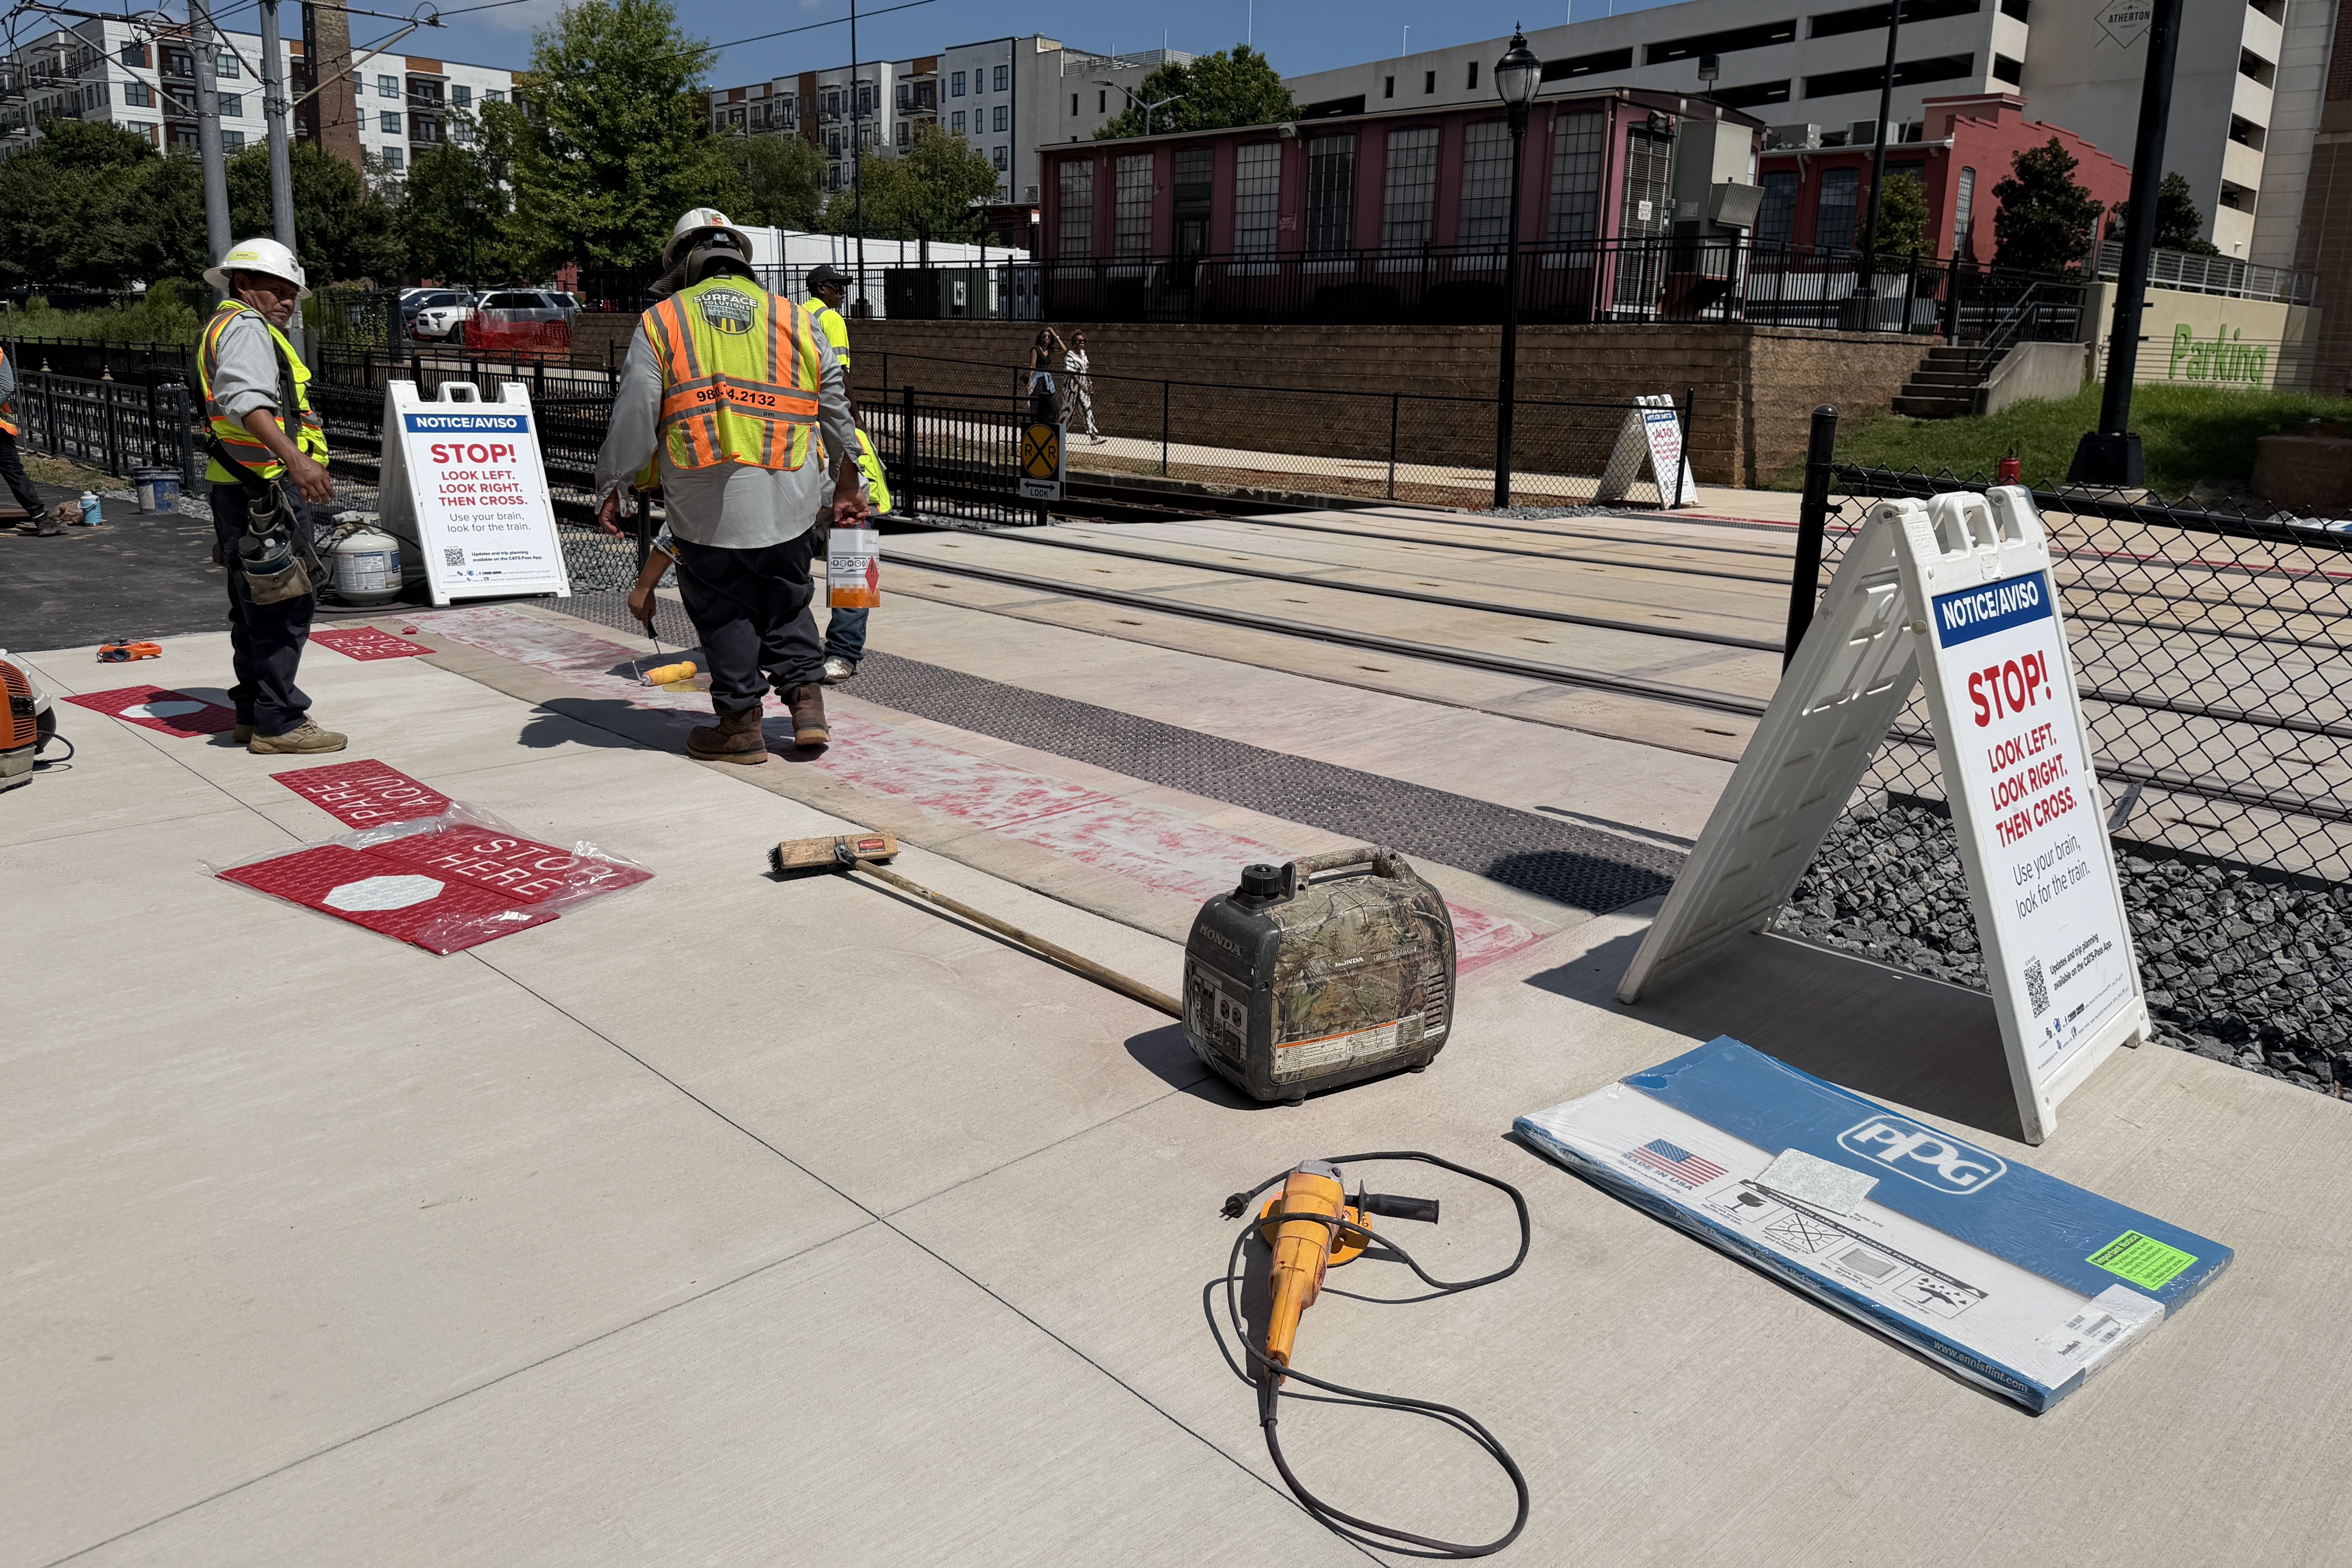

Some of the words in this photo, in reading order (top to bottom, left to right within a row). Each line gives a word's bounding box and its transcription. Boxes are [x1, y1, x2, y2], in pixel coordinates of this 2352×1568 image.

[2108, 11, 2150, 23] ATHERTON
[693, 294, 758, 308] SURFACE
[703, 301, 750, 310] SOLUTIONS
[2168, 323, 2268, 385] Parking
[416, 417, 517, 428] NOTICE/AVISO
[431, 443, 517, 464] STOP!
[1025, 443, 1032, 457] R
[1048, 446, 1056, 459] R
[439, 484, 477, 493] LOOK
[480, 483, 523, 493] RIGHT.
[441, 471, 479, 480] LOOK
[482, 471, 515, 480] LEFT.
[438, 497, 476, 506] THEN
[479, 496, 527, 506] CROSS.
[1031, 489, 1048, 497] LOOK
[448, 524, 469, 532] look
[472, 523, 485, 532] for
[450, 513, 469, 521] Use
[472, 514, 494, 523] your
[497, 512, 525, 520] brain,
[1942, 581, 2039, 630] NOTICE/AVISO
[358, 635, 418, 651] STOP
[1968, 650, 2051, 728] STOP!
[1988, 735, 2025, 774] LOOK
[2024, 722, 2057, 756] LEFT.
[1991, 772, 2029, 812] LOOK
[2028, 753, 2068, 793] RIGHT.
[307, 781, 396, 819] PARE
[1996, 808, 2033, 848] THEN
[2034, 786, 2077, 827] CROSS.
[426, 853, 565, 895] HERE
[474, 839, 613, 876] STOP
[2013, 863, 2033, 886] Use
[2033, 849, 2055, 880] your
[2054, 833, 2081, 861] brain,
[2016, 890, 2038, 919] look
[2038, 884, 2051, 905] for
[2052, 874, 2068, 896] the
[2067, 859, 2090, 885] train.
[1199, 923, 1242, 957] HONDA
[1335, 957, 1364, 967] HONDA
[1374, 946, 1416, 961] EU2000i
[2049, 957, 2067, 975] Updates
[2067, 949, 2075, 962] and
[2081, 933, 2099, 953] planning
[2053, 971, 2072, 991] available
[2071, 968, 2077, 977] on
[2076, 961, 2084, 973] the
[2103, 940, 2113, 952] App.
[1619, 1152, 1655, 1171] MADE
[1653, 1169, 1668, 1178] IN
[1668, 1177, 1695, 1190] USA
[1853, 1123, 1991, 1186] PPG
[1760, 1230, 1782, 1241] Protect
[1780, 1239, 1799, 1249] against
[1766, 1193, 1797, 1207] HANDLE
[1794, 1206, 1815, 1216] WITH
[1813, 1216, 1839, 1227] CARE.
[1835, 1226, 1859, 1237] OPEN
[1856, 1236, 1893, 1253] PACKAGE
[1892, 1253, 1916, 1264] FROM
[1914, 1263, 1936, 1273] THIS
[1933, 1272, 1957, 1284] SIDE.
[2093, 1245, 2126, 1265] Important
[2117, 1233, 2140, 1247] Notice
[1820, 1262, 1833, 1271] Max.
[1857, 1282, 1874, 1290] high
[1934, 1340, 2028, 1393] www.ennisflint.com
